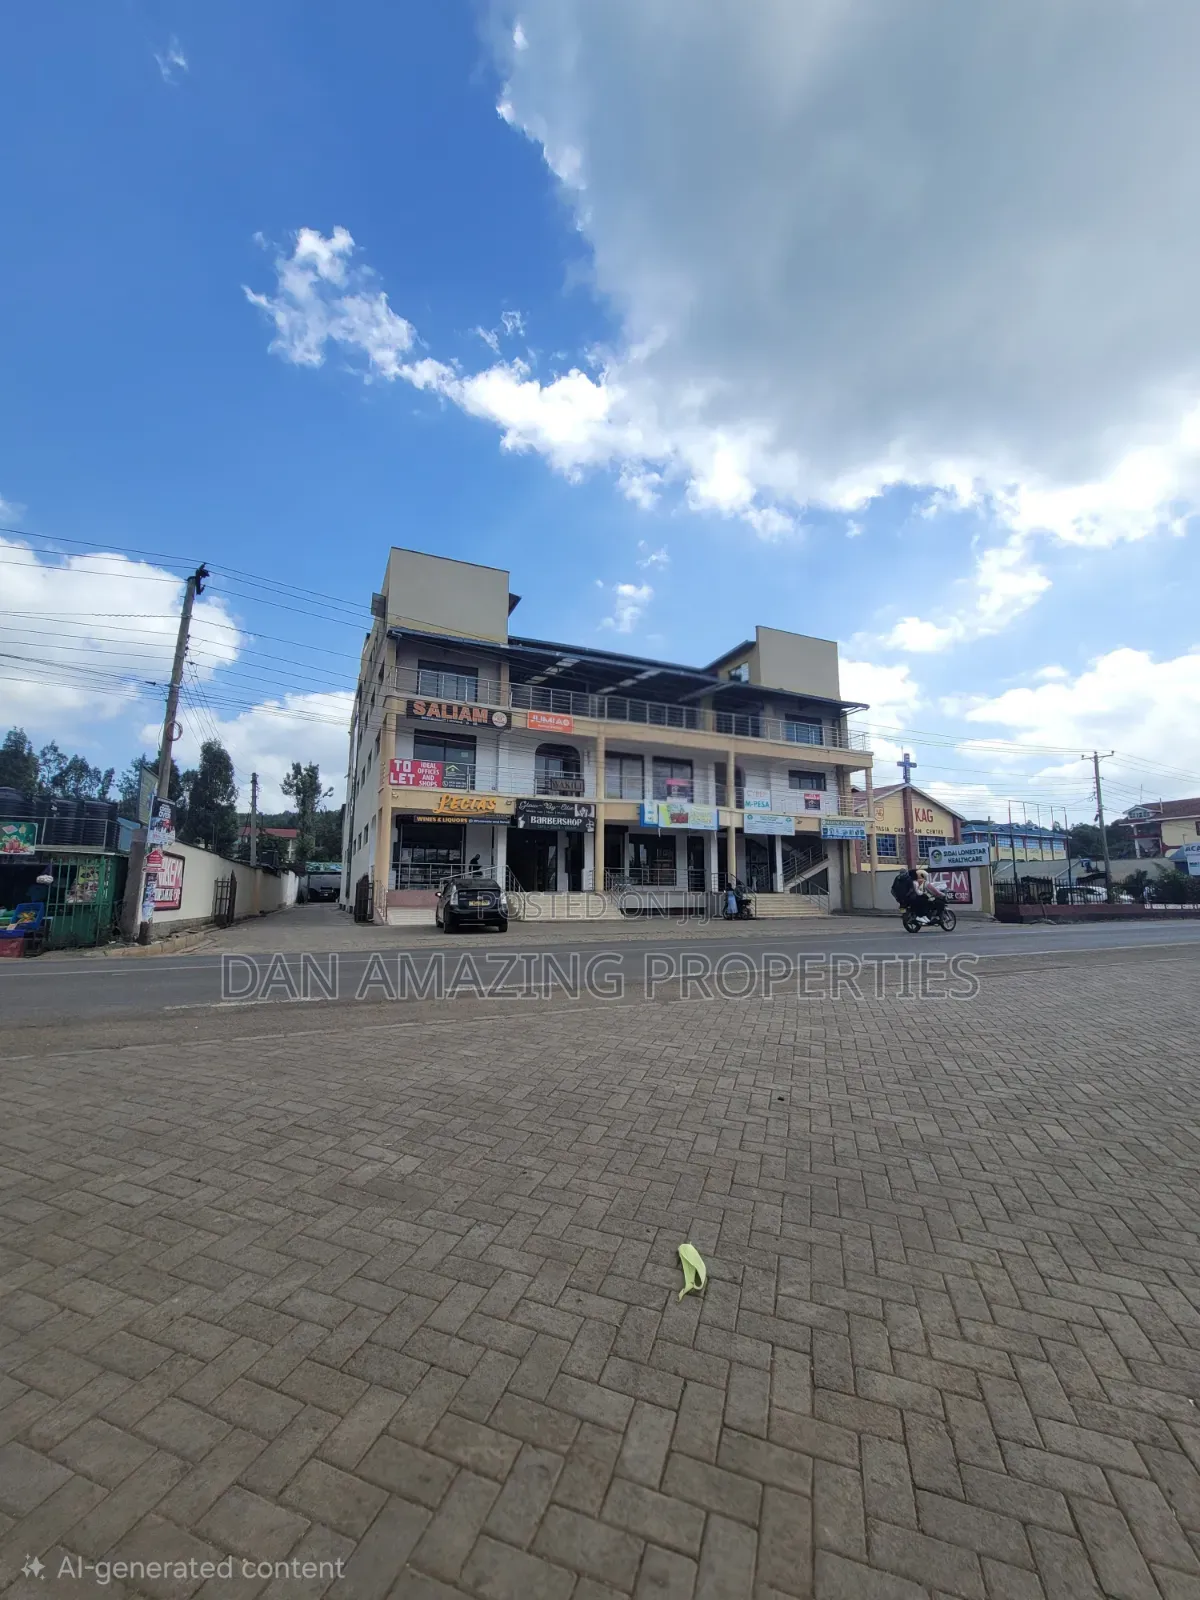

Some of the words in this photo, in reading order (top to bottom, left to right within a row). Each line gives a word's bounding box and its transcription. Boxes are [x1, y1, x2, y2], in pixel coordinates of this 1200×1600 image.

[412, 700, 489, 724] SALIAM
[394, 759, 412, 773] TO
[417, 768, 440, 776] OFFICES
[389, 772, 415, 785] LET
[418, 780, 438, 788] SHOPS
[745, 800, 770, 808] M-PESA
[914, 807, 934, 823] KAG
[958, 847, 987, 856] LONESTAR
[947, 855, 983, 864] HEALTHCARE
